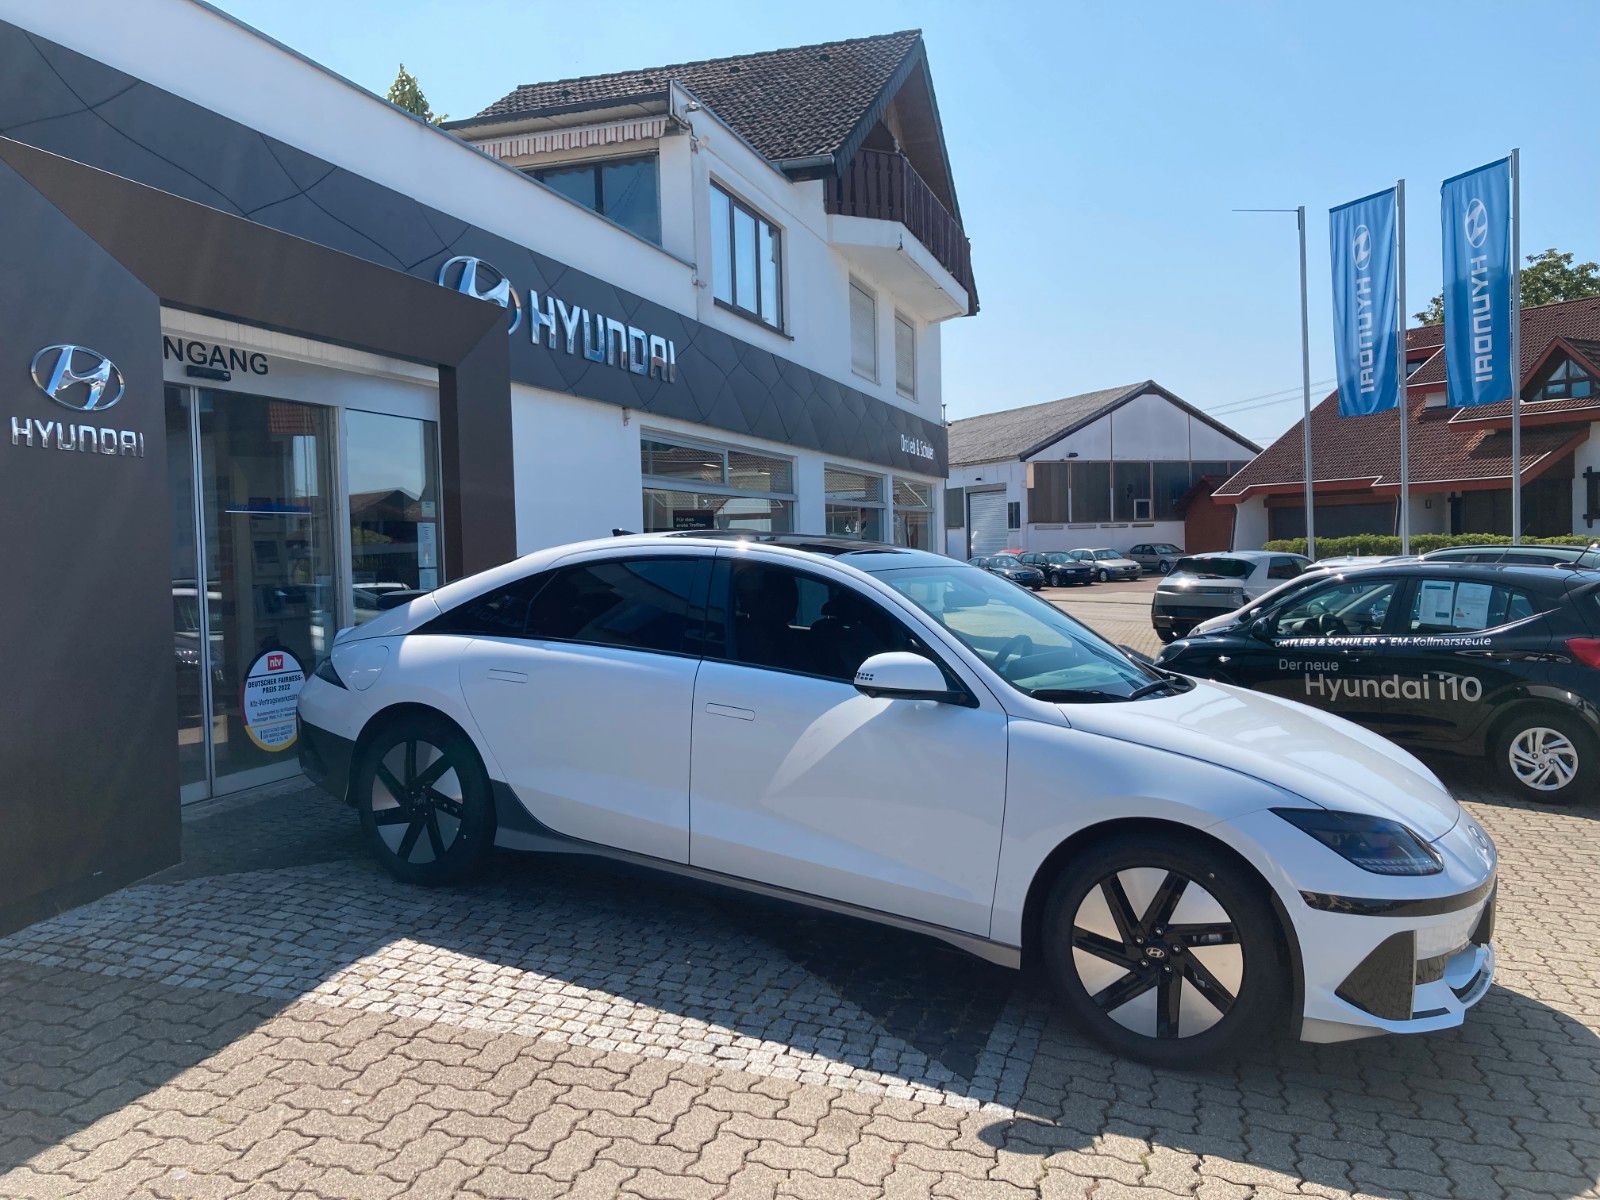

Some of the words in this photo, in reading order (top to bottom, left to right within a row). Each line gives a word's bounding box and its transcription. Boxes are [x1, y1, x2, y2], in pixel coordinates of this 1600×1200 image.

[529, 289, 676, 384] HYUNDAI
[11, 416, 145, 458] HYUNDAI
[1275, 638, 1317, 648] ORTLIEB
[1317, 638, 1326, 647] &
[1327, 637, 1377, 647] SCHULER
[1278, 658, 1302, 671] Der
[1304, 660, 1340, 671] neue
[248, 677, 277, 688] DEUTSCHER
[1304, 673, 1430, 702] Hyundai
[1438, 673, 1483, 702] i10
[262, 685, 277, 694] PREIS
